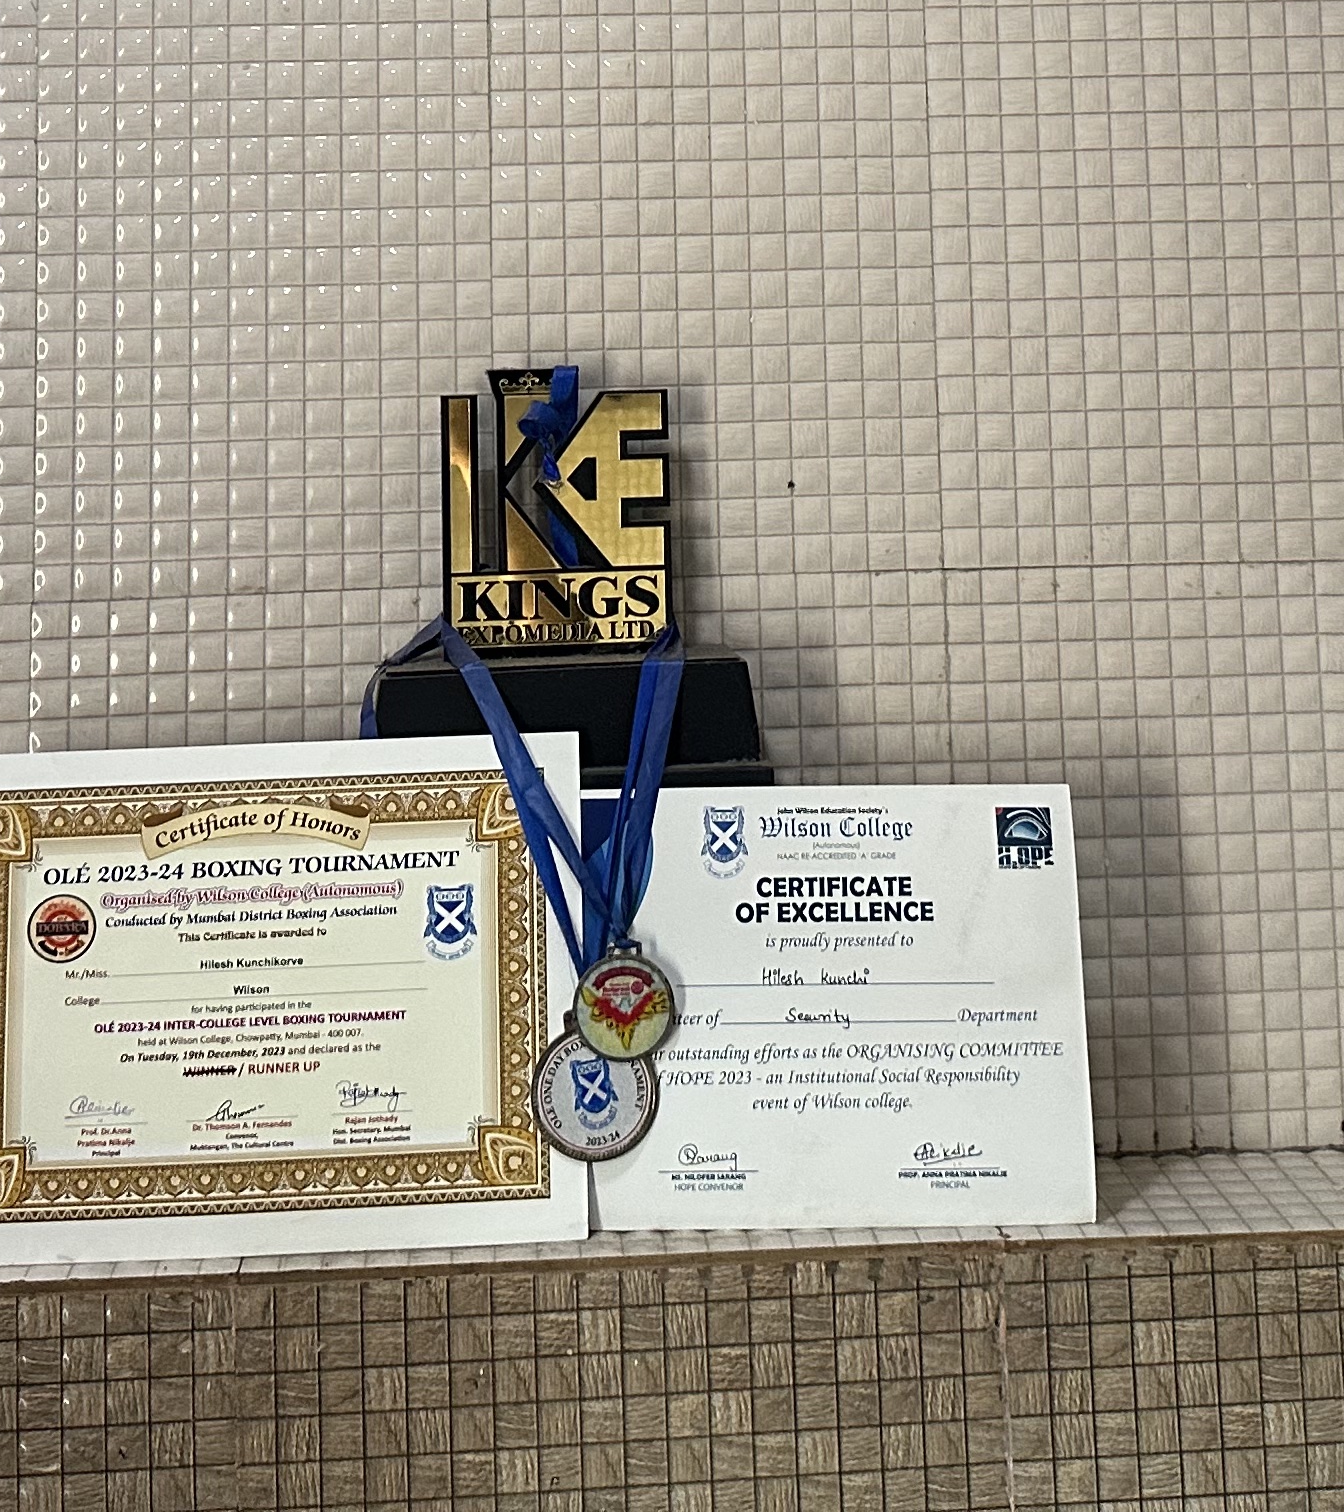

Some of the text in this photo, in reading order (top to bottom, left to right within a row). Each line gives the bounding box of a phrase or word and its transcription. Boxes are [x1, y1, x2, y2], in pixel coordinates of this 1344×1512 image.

[457, 574, 660, 622] KINGS
[457, 621, 604, 646] EXPOMEDIA
[155, 808, 361, 850] Certificate of Honors
[760, 816, 914, 841] Wilson College
[44, 851, 460, 886] OLÉ 2023-24 BOXING TOURNAMENT
[756, 876, 913, 898] CERTIFICATE
[105, 905, 398, 929] Conducted by Mumbai District Boxing Association
[735, 901, 935, 924] OF EXCELLENCE
[765, 932, 914, 952] is proudly presented to
[237, 955, 304, 968] Kunchikorve
[233, 985, 270, 996] Wilson
[94, 1009, 407, 1034] OLÉ 2023-24 INTER-COLLEGE LEVEL BOXING TOURNAMENT
[706, 1008, 724, 1030] of
[958, 1007, 1038, 1025] Department
[667, 1041, 1064, 1064] outstanding efforts as the ORGANISING COMMITTEE
[248, 1061, 321, 1076] RUNNER UP
[666, 1065, 1021, 1088] HOPE 2023 an Institutional Social Responsibility
[543, 1056, 566, 1130] OLE ONE DAY
[752, 1092, 913, 1115] event of Wilson college.
